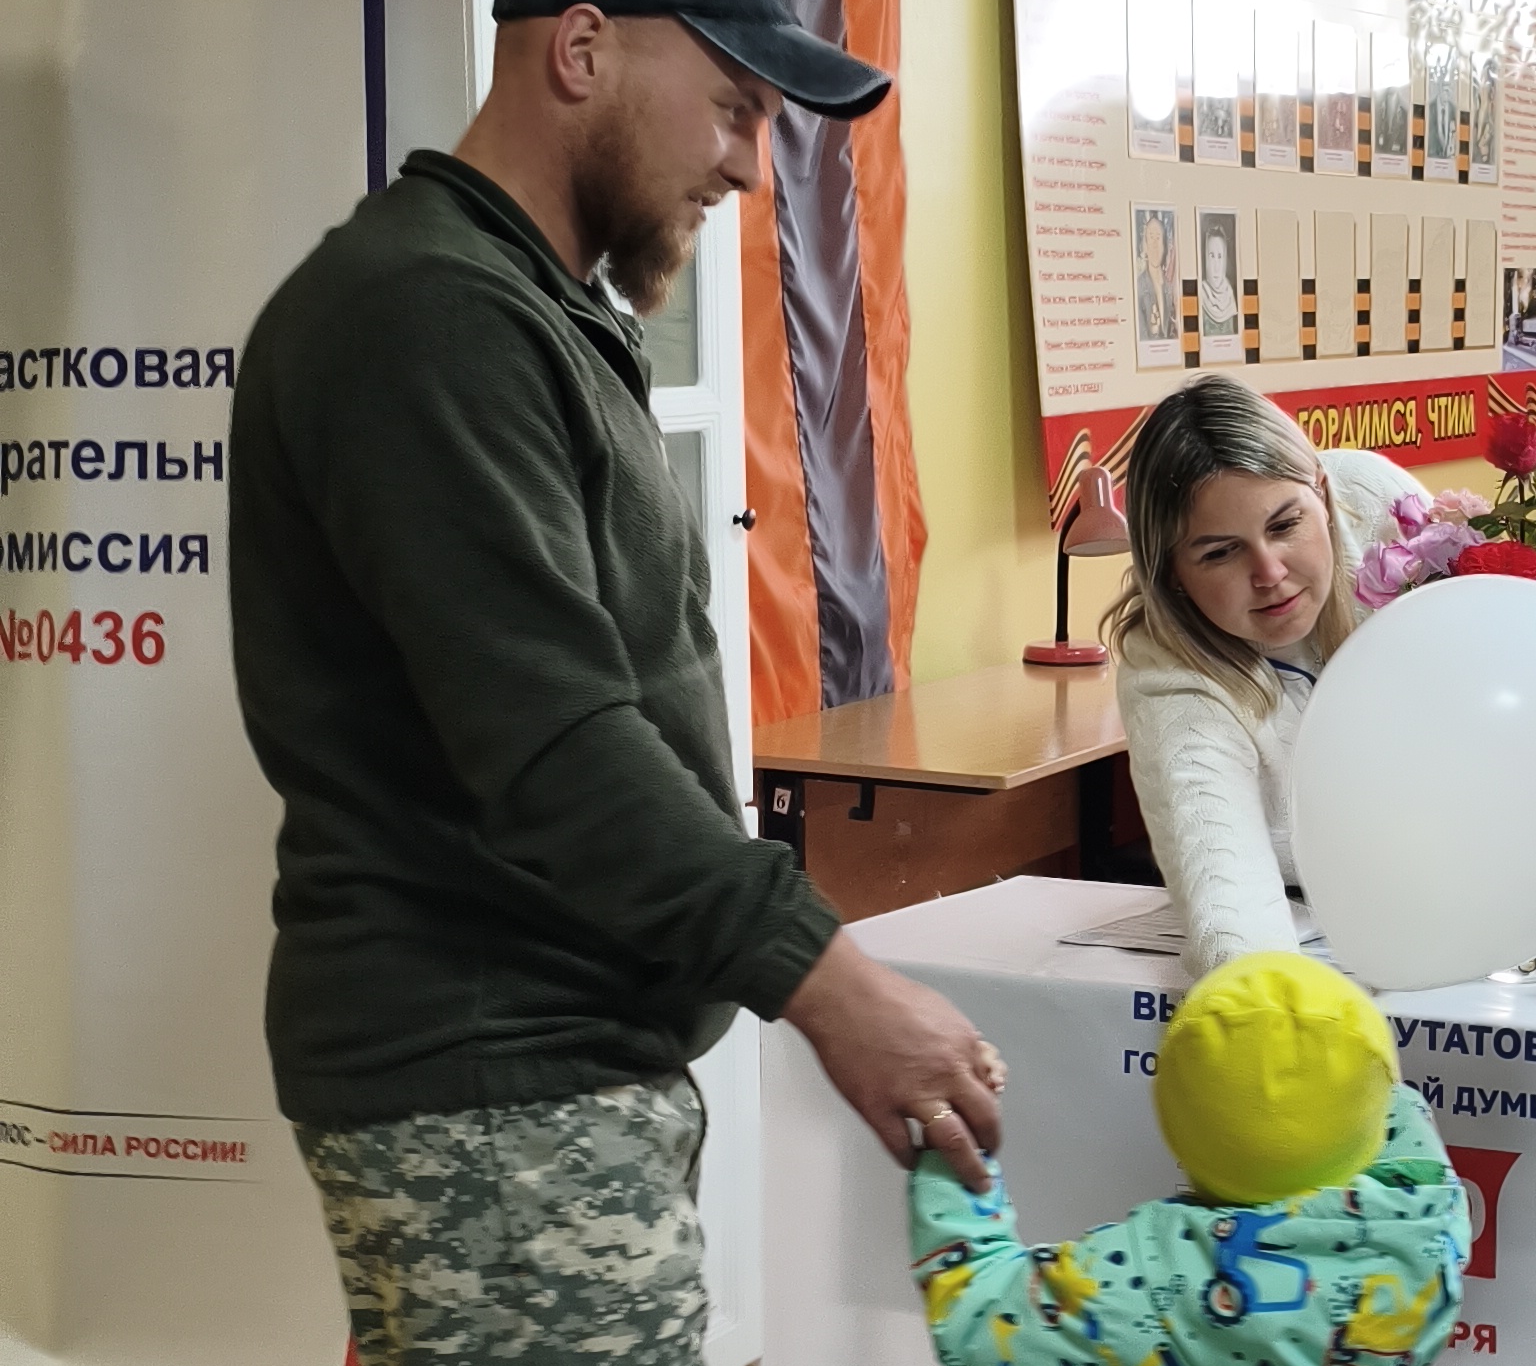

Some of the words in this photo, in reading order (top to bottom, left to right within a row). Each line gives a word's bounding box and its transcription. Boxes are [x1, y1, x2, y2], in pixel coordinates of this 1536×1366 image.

[0, 346, 235, 391] астковая
[1427, 392, 1477, 438] ЧТИМ
[1, 439, 224, 496] рательн
[0, 531, 209, 574] миссия
[0, 609, 165, 665] №0436
[49, 1131, 117, 1156] СИЛА
[124, 1136, 247, 1163] РОССИИ!
